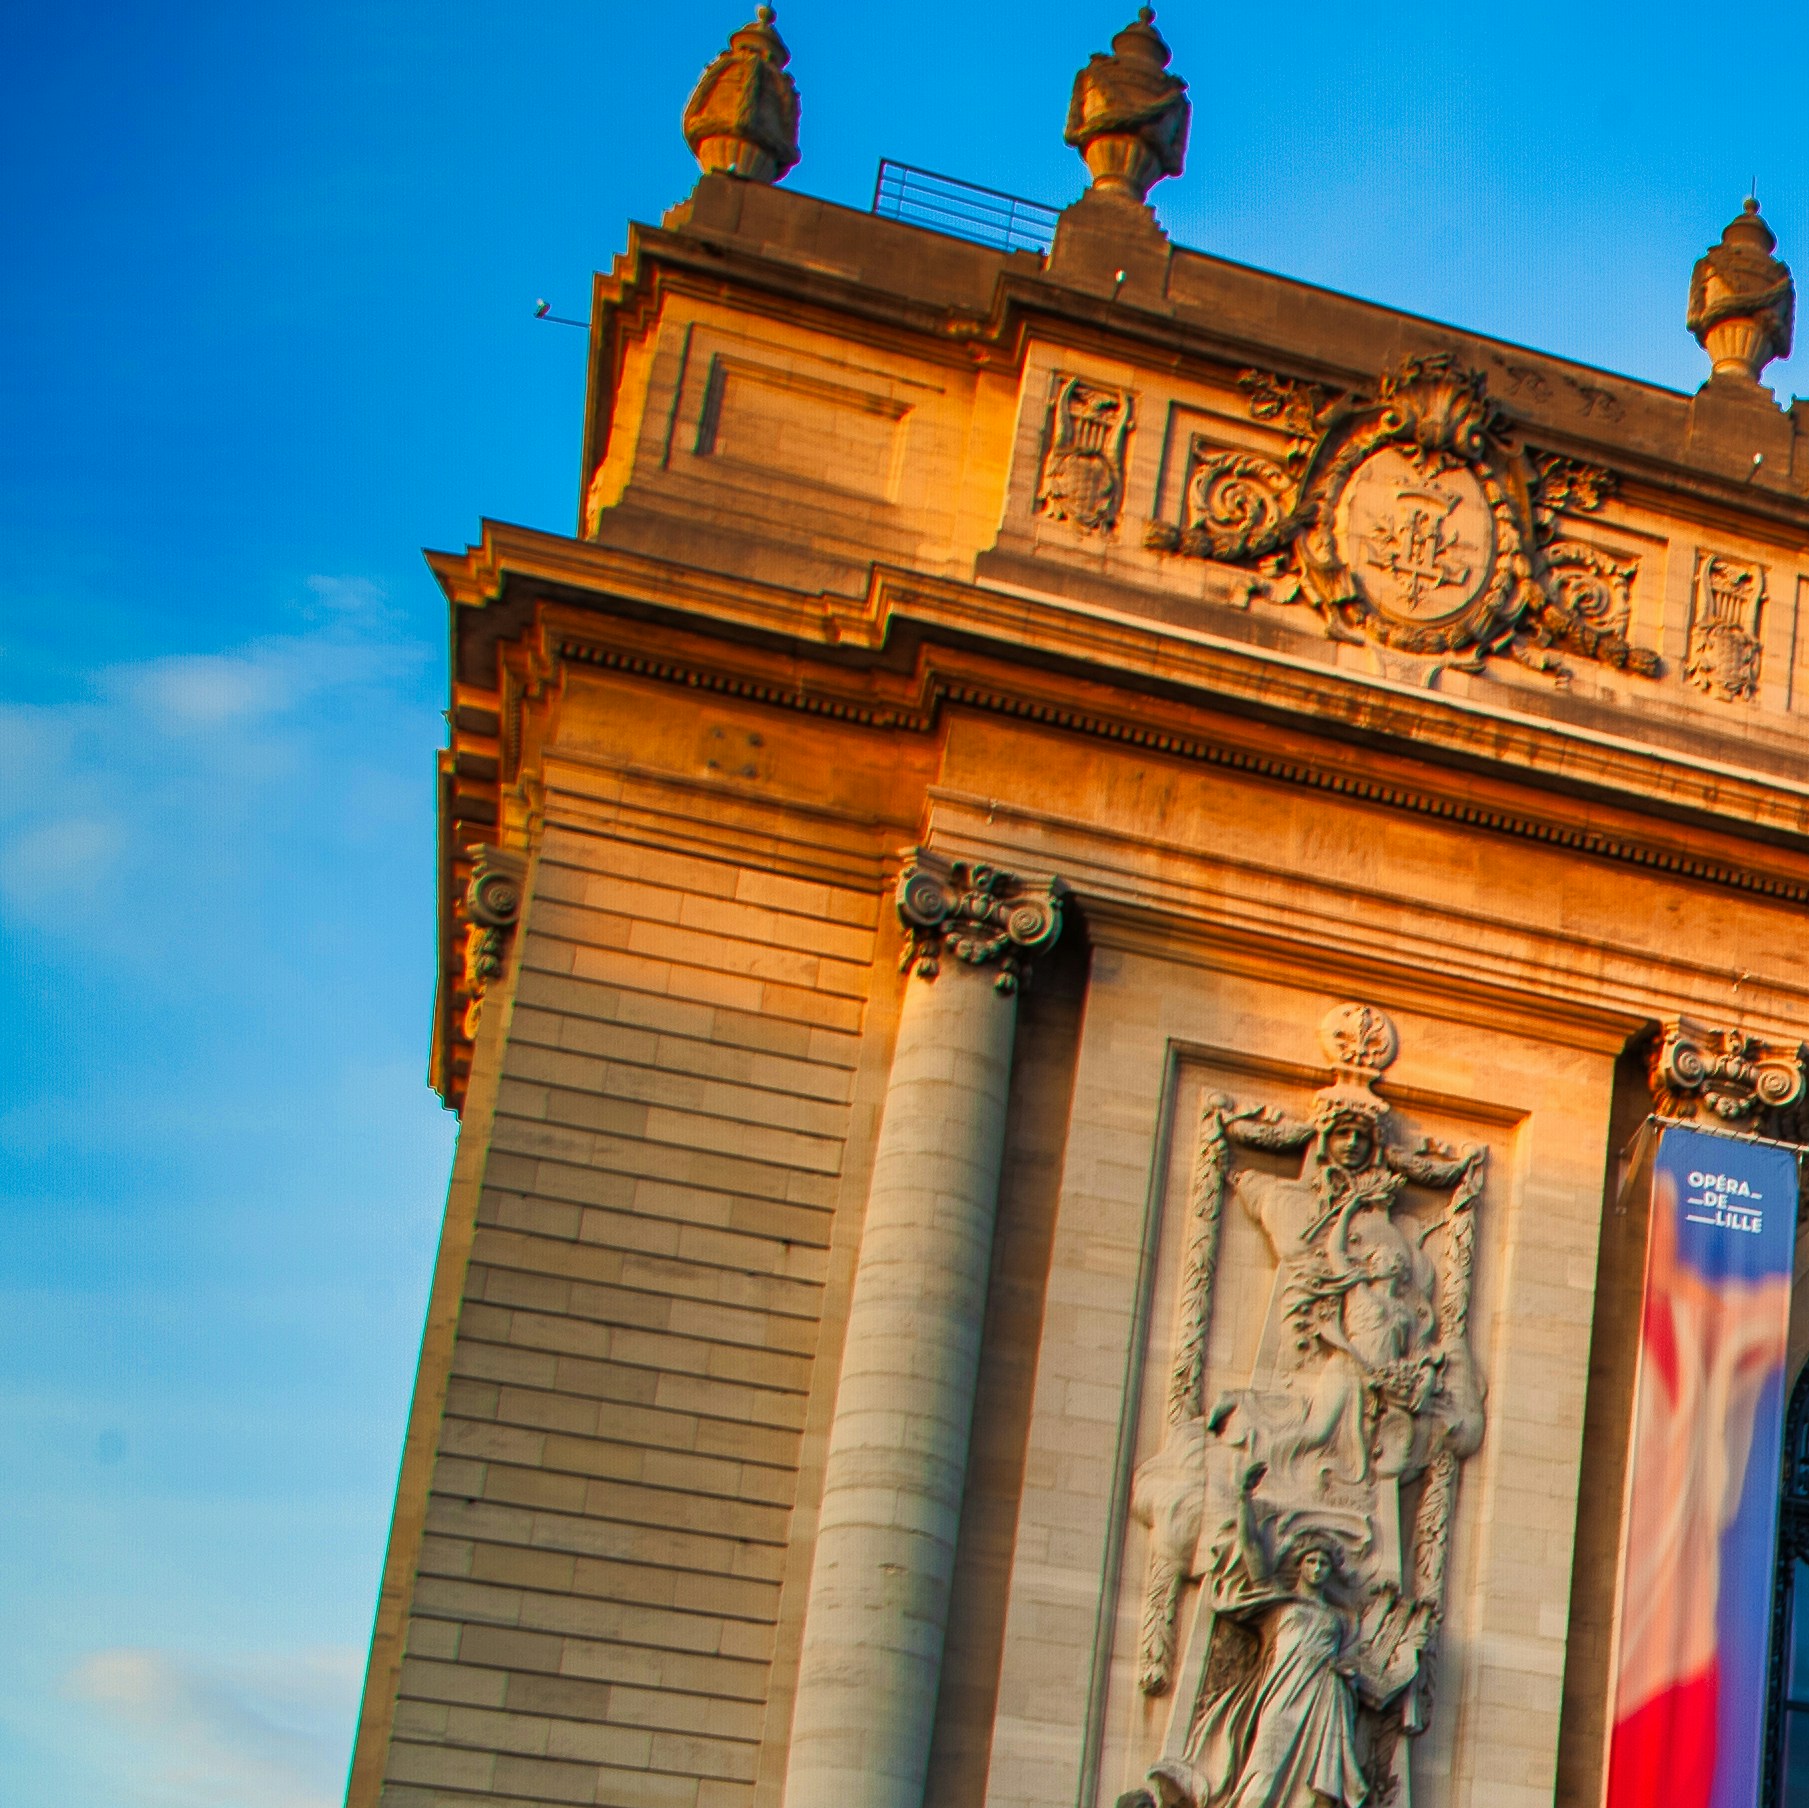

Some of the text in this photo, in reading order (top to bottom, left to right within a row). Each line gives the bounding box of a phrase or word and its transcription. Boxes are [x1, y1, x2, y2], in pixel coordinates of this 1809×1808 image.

[1687, 1170, 1751, 1198] OPÉRA
[1703, 1191, 1728, 1210] DE
[1714, 1210, 1763, 1234] LILLE
